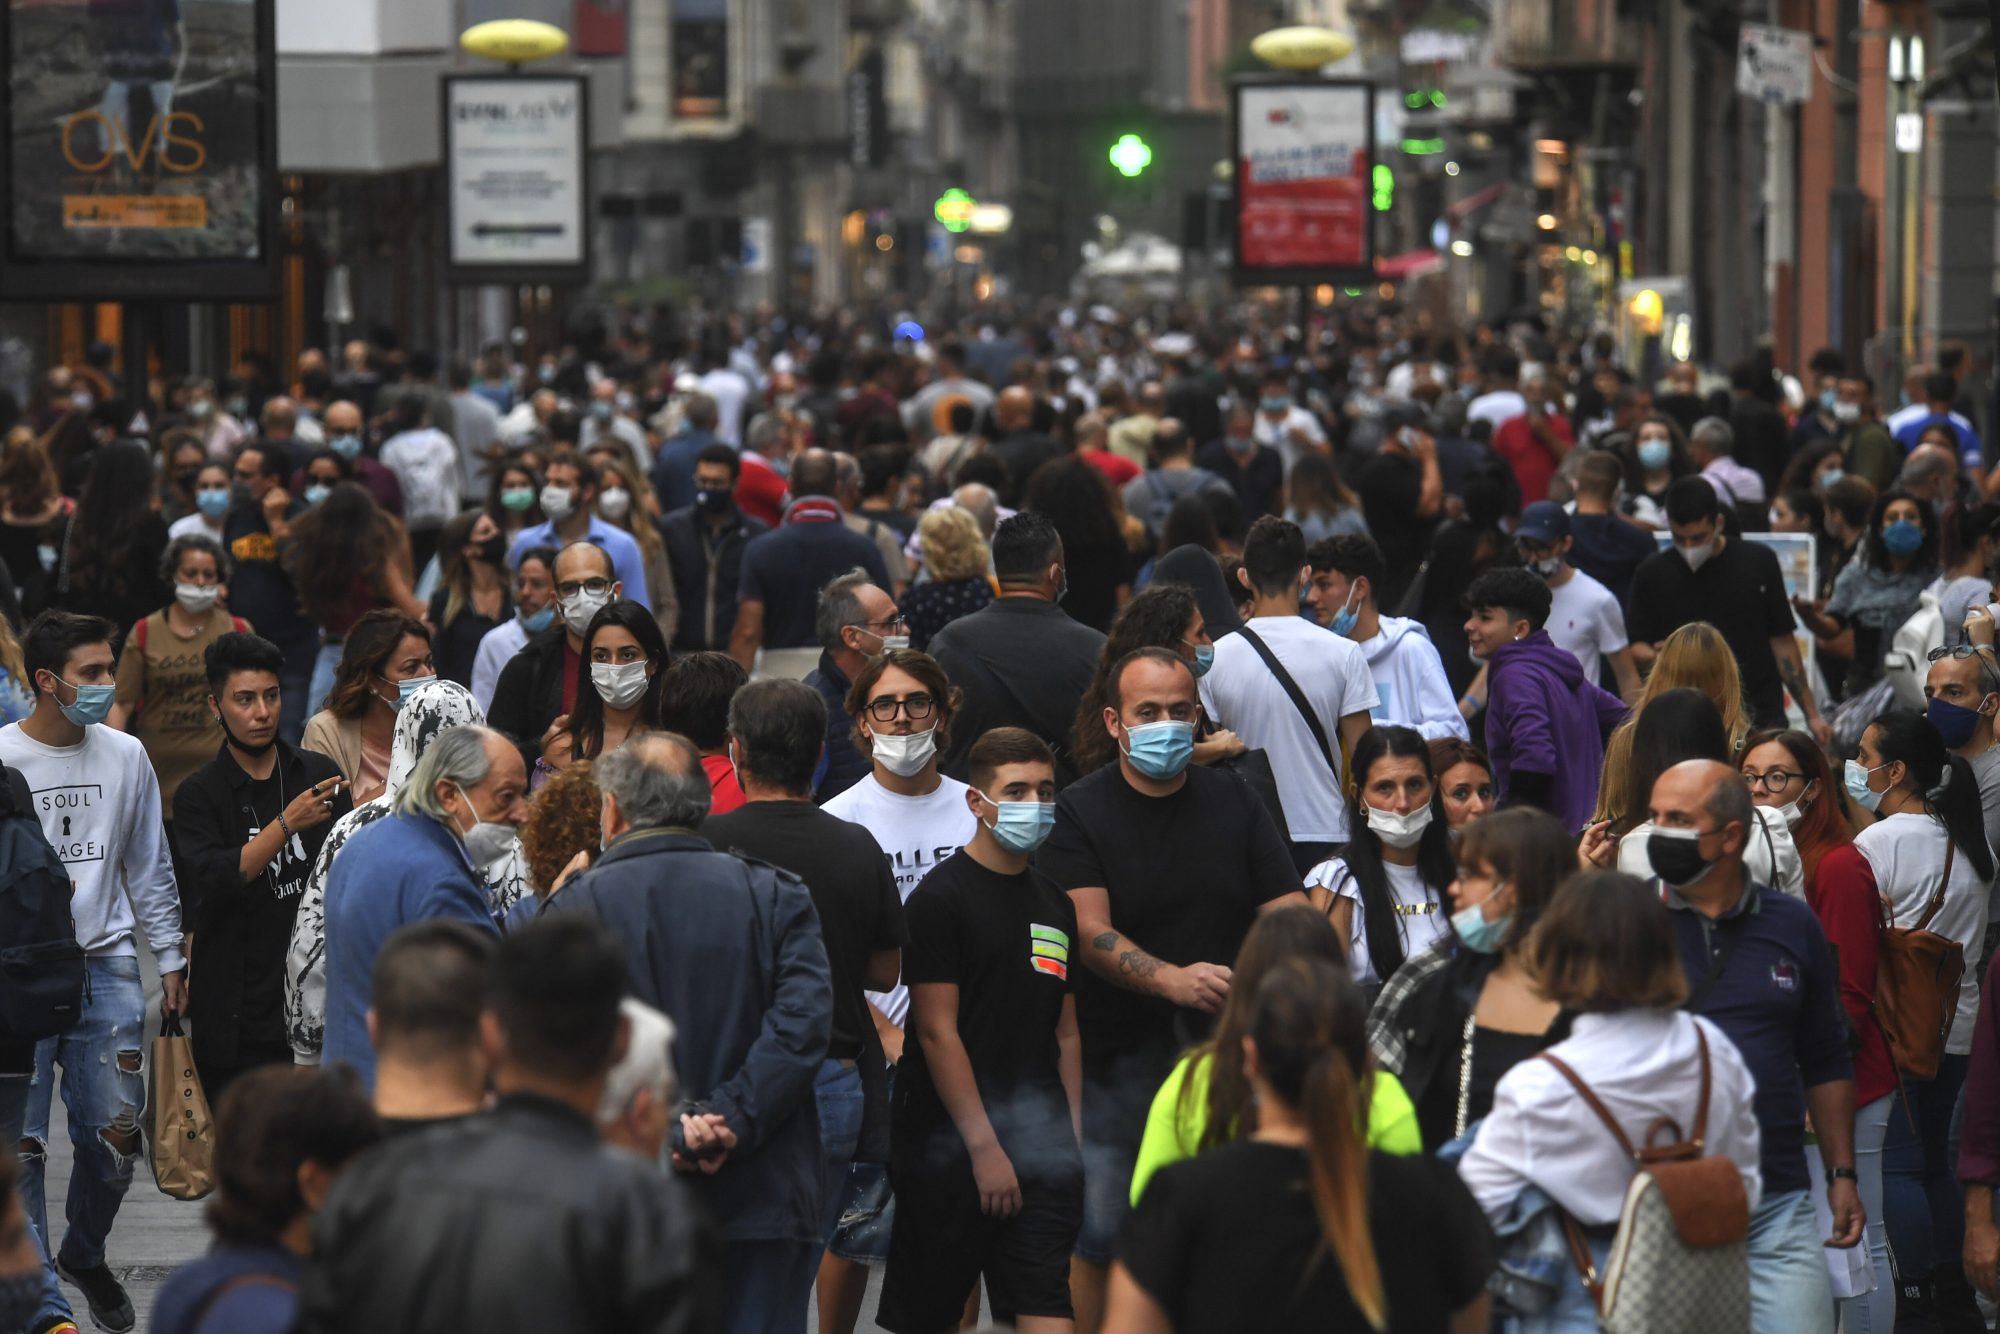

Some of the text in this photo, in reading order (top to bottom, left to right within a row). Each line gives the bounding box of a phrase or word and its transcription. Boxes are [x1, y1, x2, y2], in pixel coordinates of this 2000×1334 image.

[62, 111, 206, 173] OVS
[42, 793, 91, 811] SOUL
[51, 841, 95, 858] AGE
